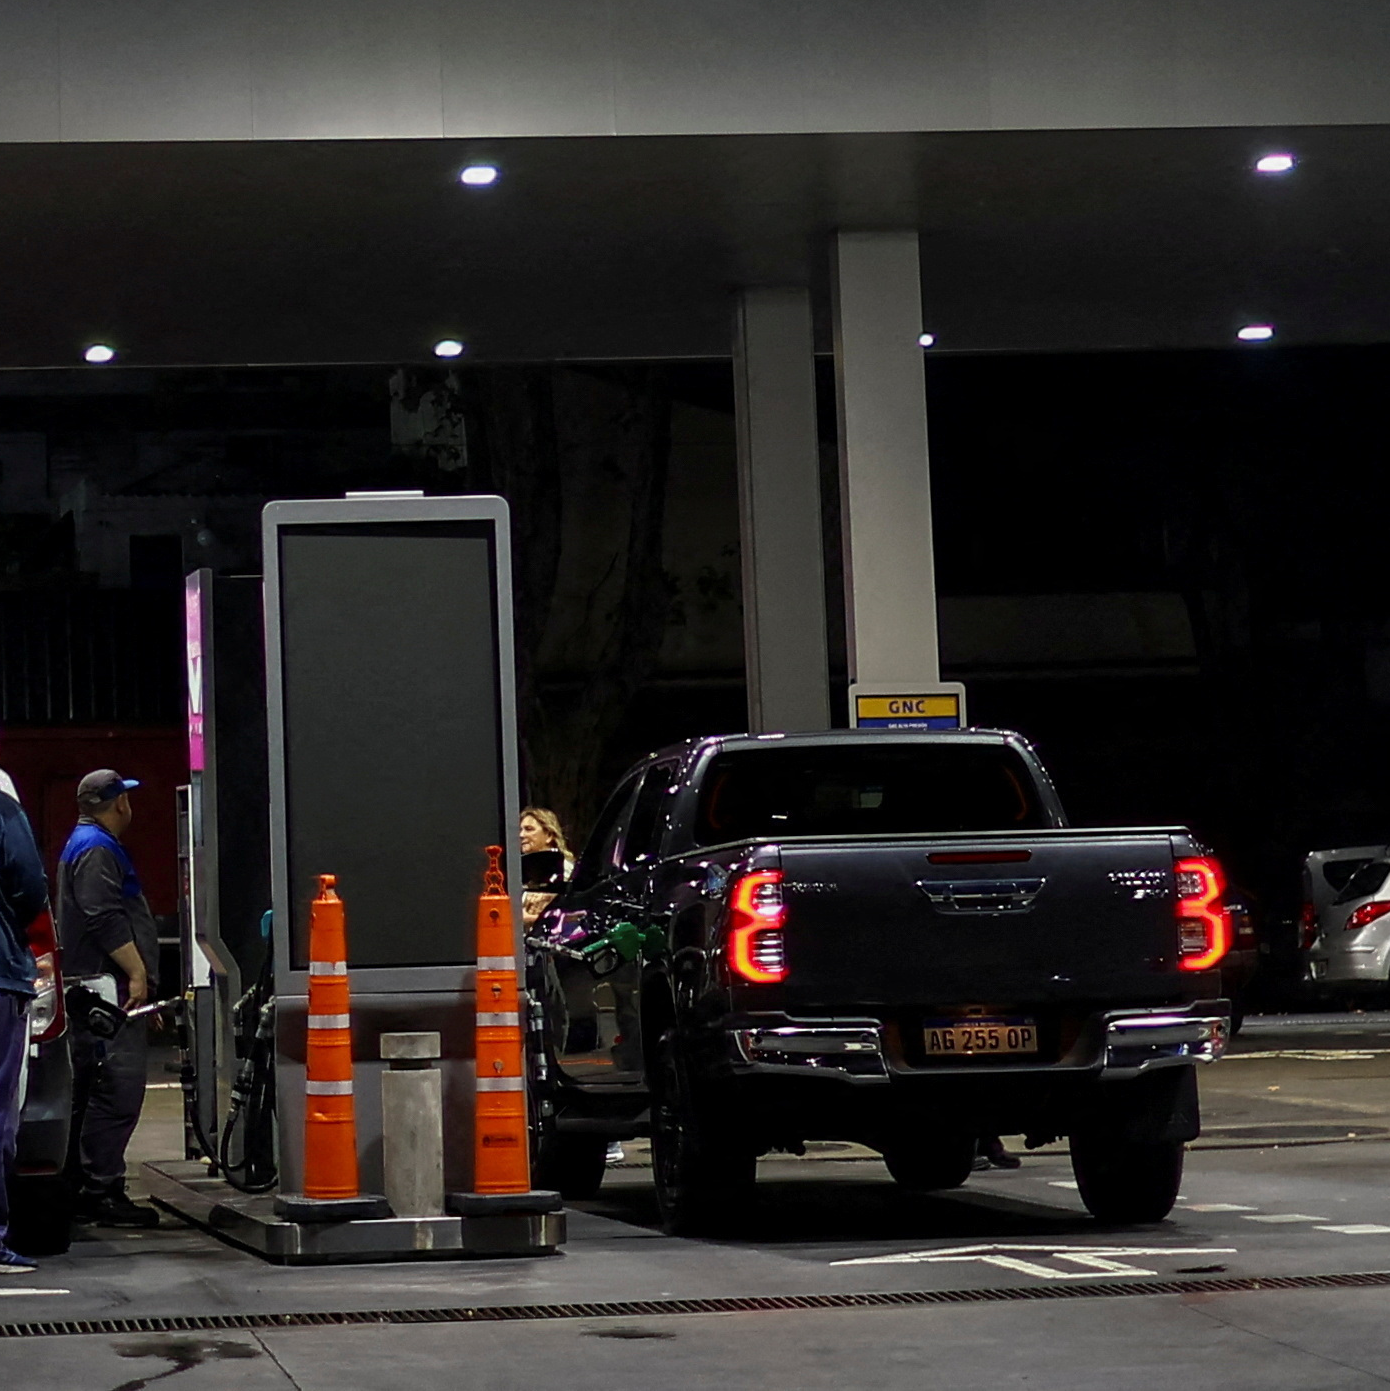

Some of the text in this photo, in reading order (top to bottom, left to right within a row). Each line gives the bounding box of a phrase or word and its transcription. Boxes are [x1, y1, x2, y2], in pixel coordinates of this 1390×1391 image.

[888, 699, 926, 714] GNC
[930, 1028, 1032, 1051] AG 255 OP
